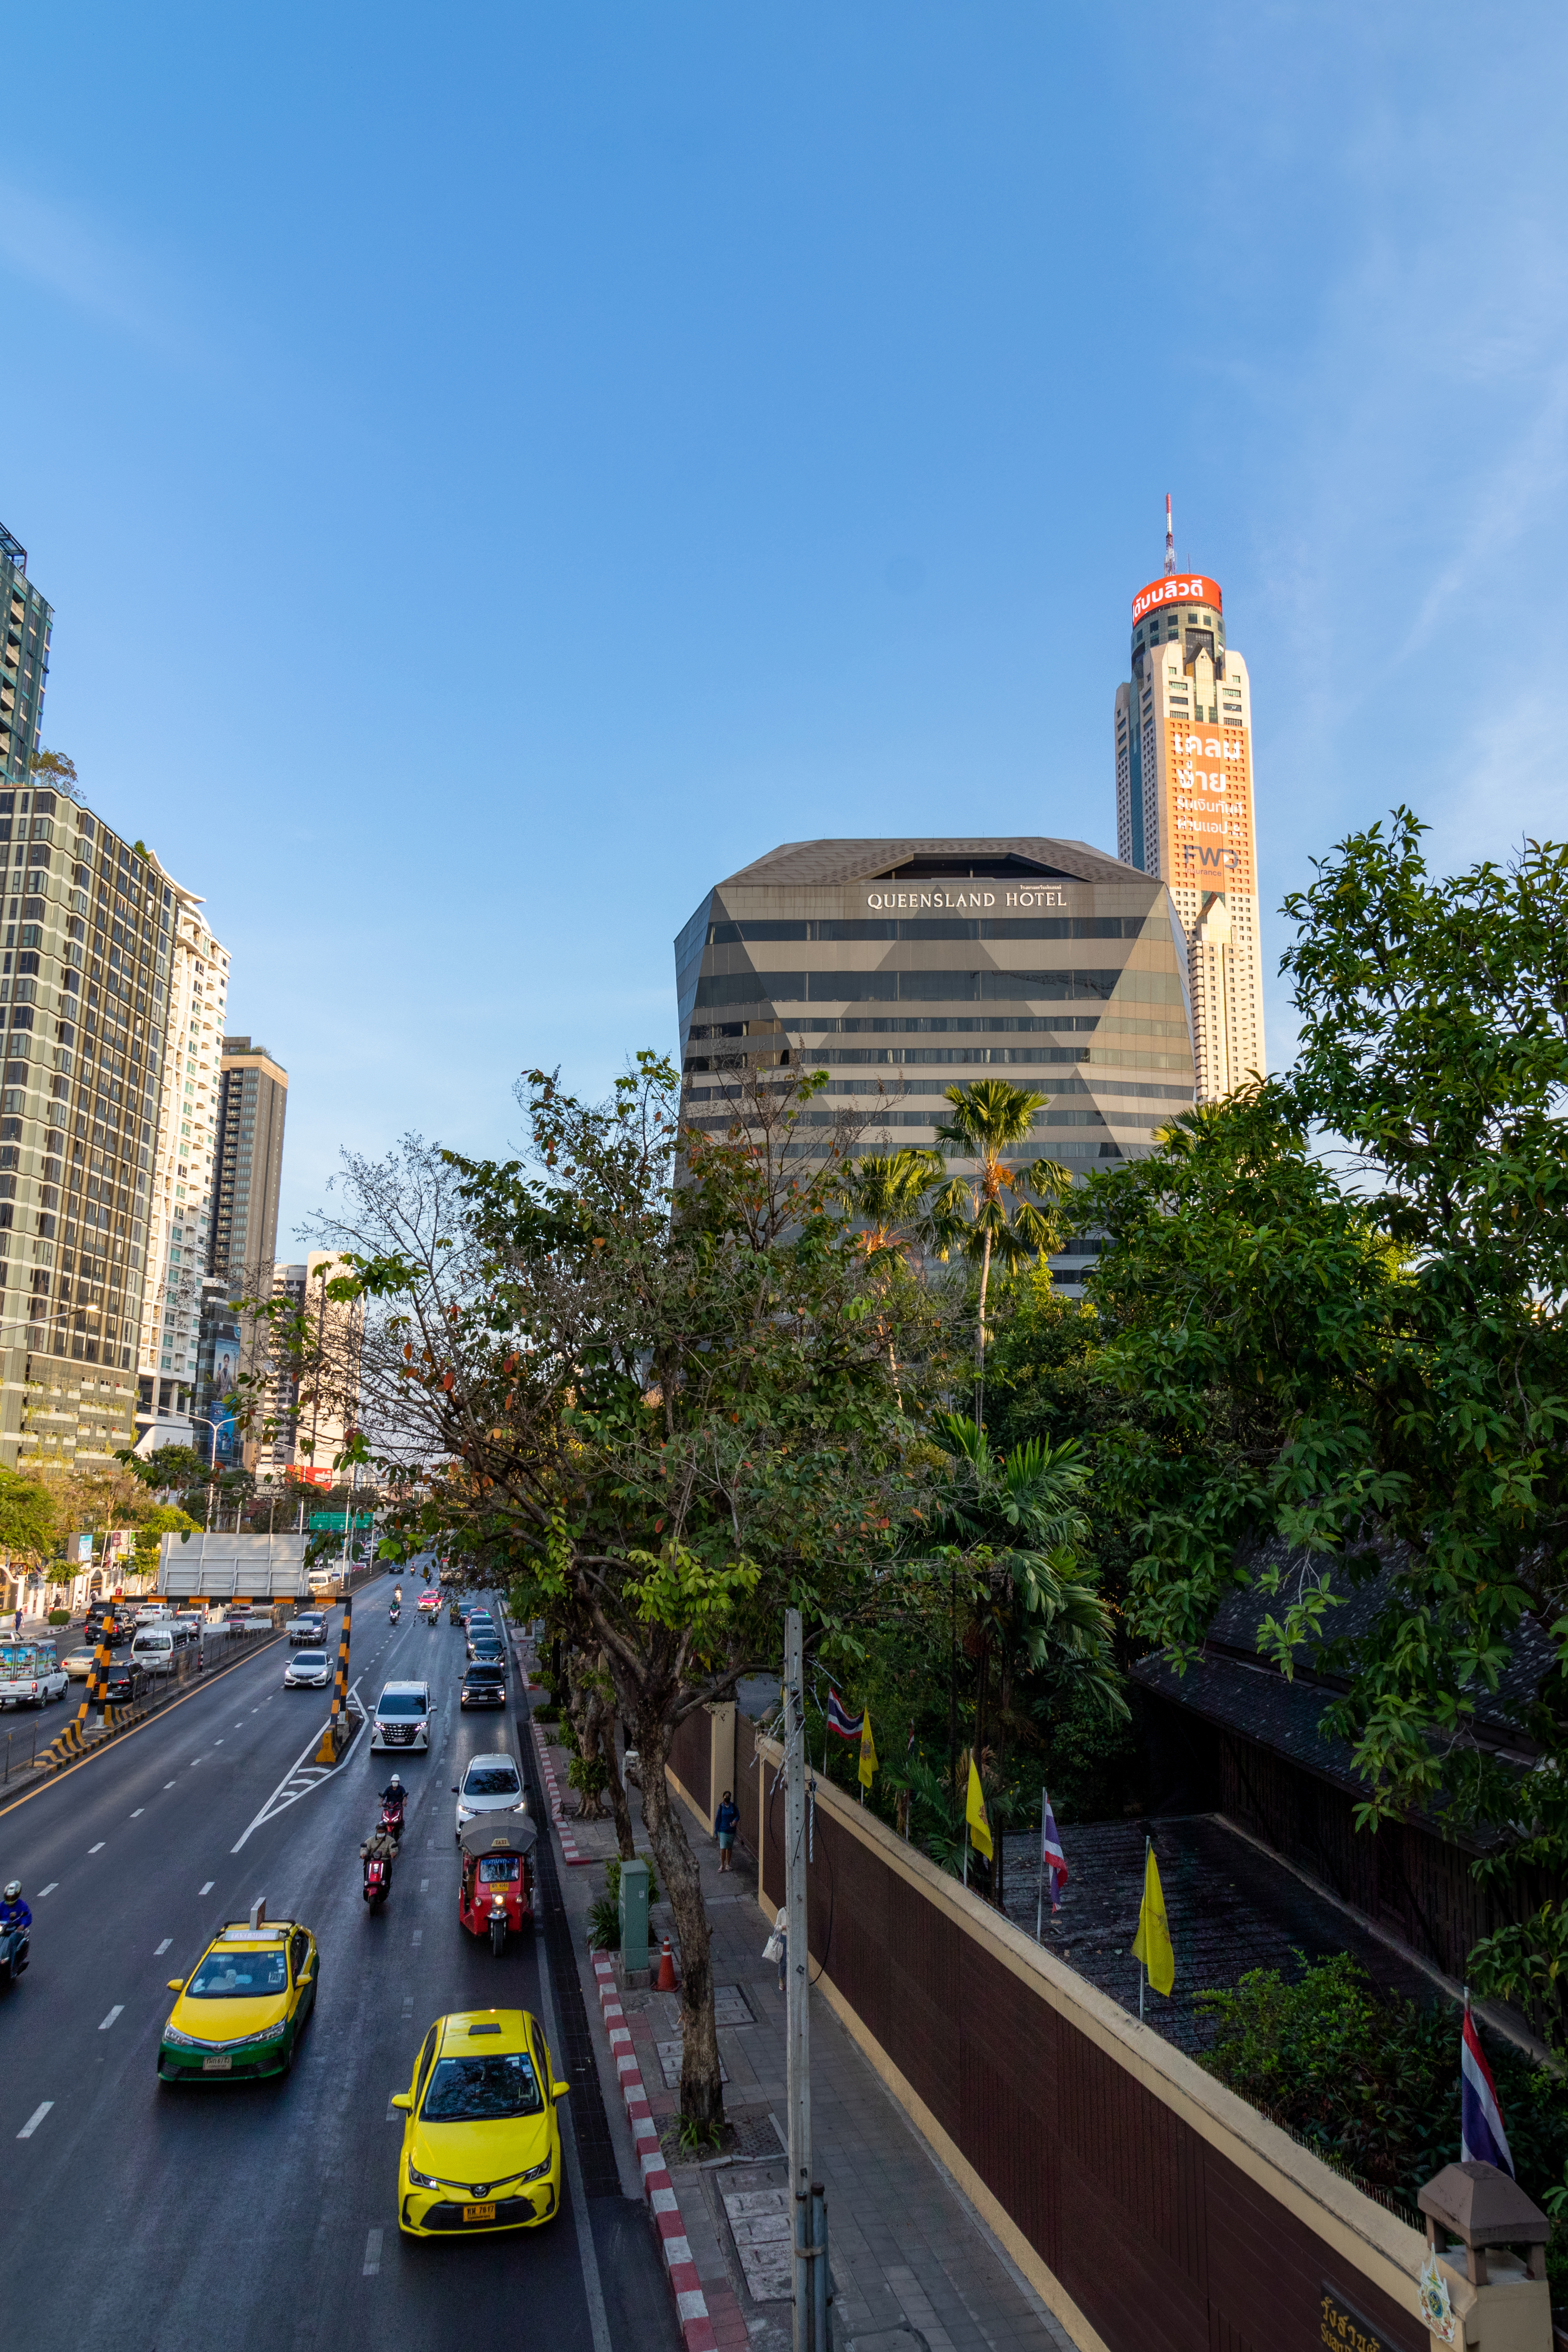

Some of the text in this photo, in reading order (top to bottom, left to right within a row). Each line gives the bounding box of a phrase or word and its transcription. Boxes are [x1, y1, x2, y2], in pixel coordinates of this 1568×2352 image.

[1133, 579, 1203, 622] ดับบลิวดี
[1174, 734, 1240, 761] เคลม
[1176, 760, 1226, 793] ง่าย
[1183, 845, 1239, 869] FWD
[867, 892, 1067, 910] QUEENSLAND HOTEL
